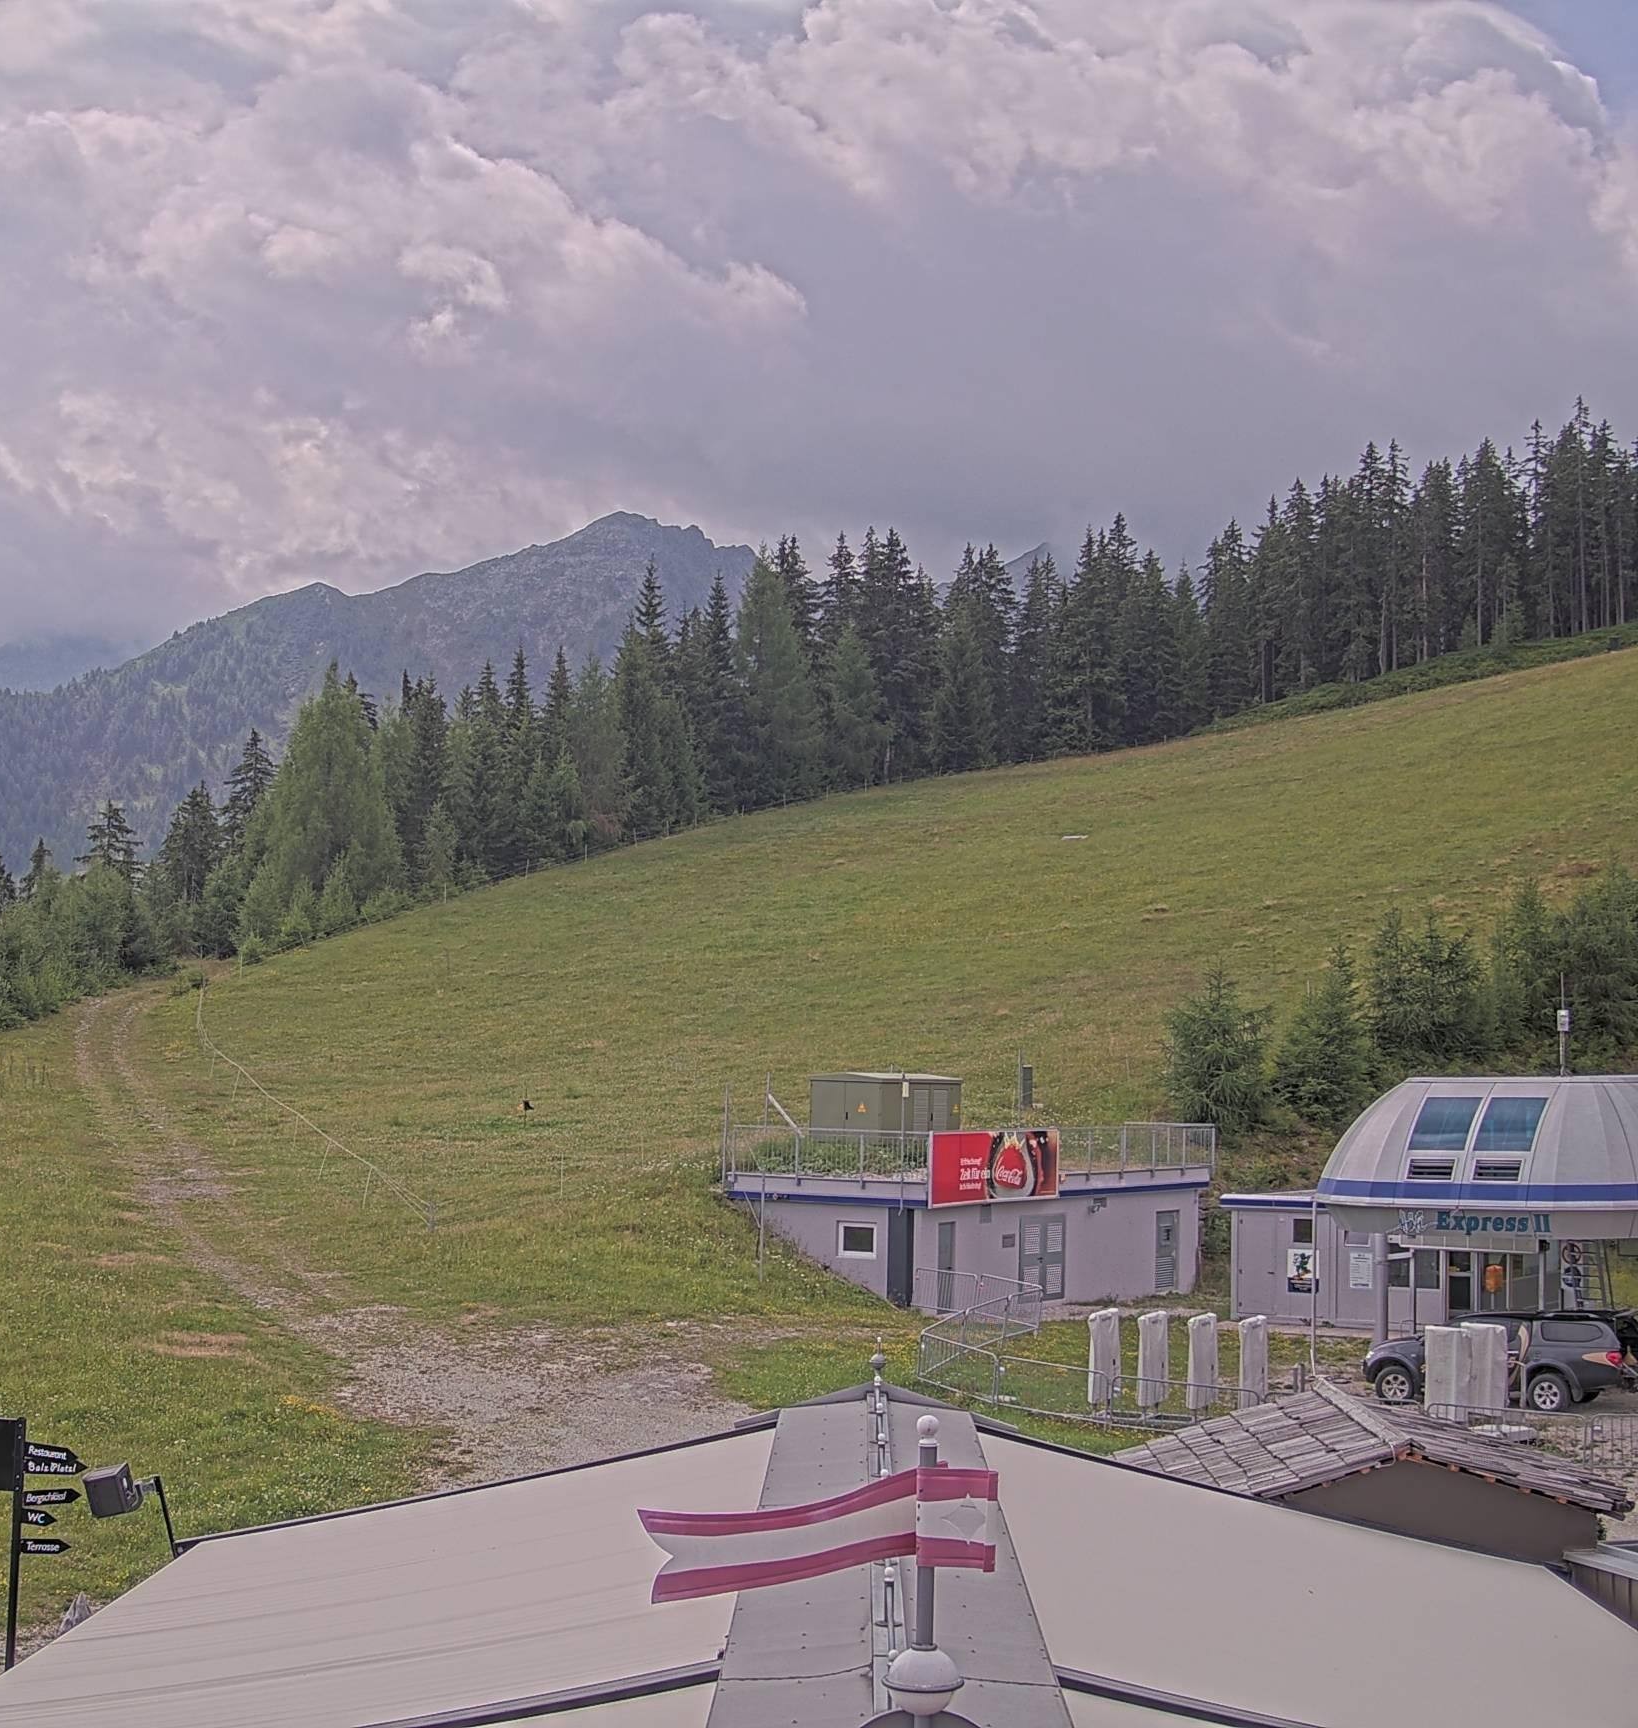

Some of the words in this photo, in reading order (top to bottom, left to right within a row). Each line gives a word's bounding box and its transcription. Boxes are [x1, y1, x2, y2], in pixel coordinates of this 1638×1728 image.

[1436, 1211, 1529, 1235] Express
[28, 1445, 67, 1461] Restaurant
[28, 1511, 46, 1524] WC
[26, 1541, 60, 1552] Terrasse
